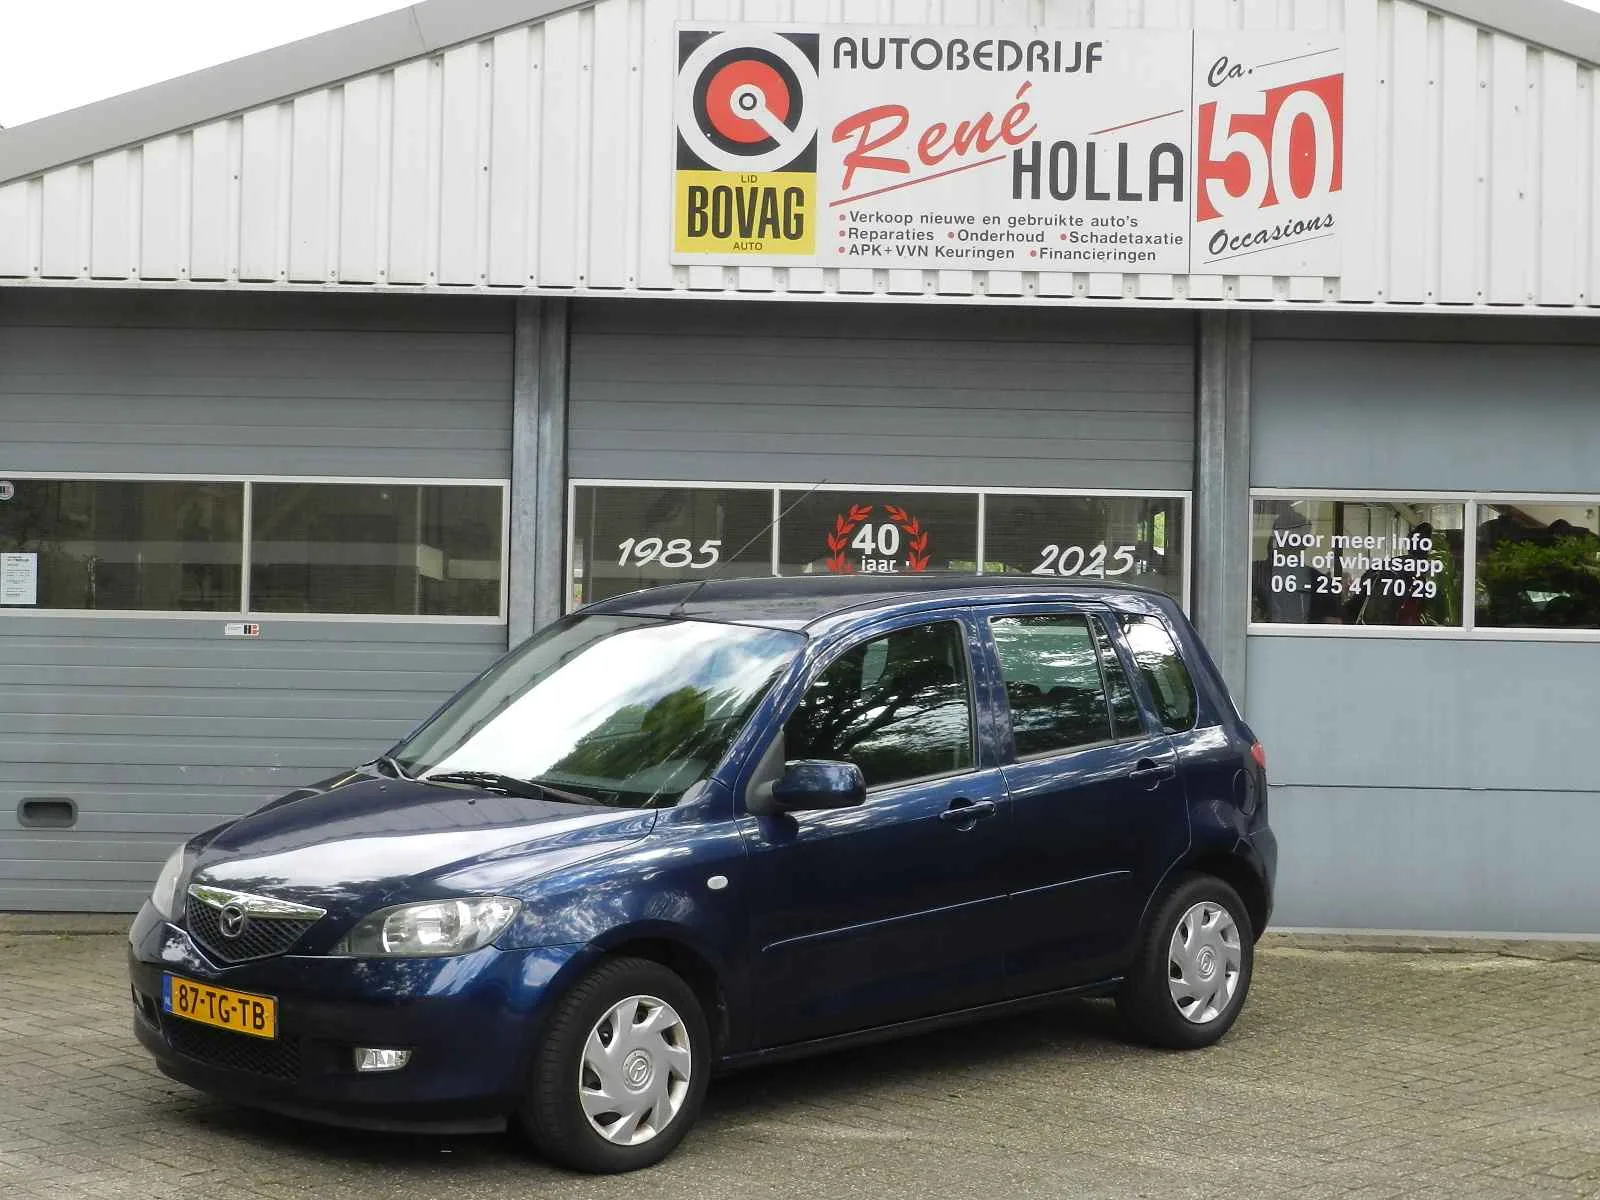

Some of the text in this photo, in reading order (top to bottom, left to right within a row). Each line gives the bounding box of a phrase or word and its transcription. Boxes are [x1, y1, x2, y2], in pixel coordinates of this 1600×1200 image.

[832, 36, 1103, 73] AUTOBEDRIJF
[1207, 56, 1253, 87] Ca.
[831, 80, 1038, 191] René
[1204, 88, 1335, 217] 50
[740, 174, 758, 184] LID
[1012, 140, 1184, 202] HOLLA
[687, 185, 805, 240] BOVAG
[849, 211, 1139, 228] Verkoop nieuwe en gebruikte auto's
[732, 242, 763, 251] AUTO
[848, 227, 1183, 245] Reparaties Onderhoud Schadetaxatie
[1208, 212, 1336, 255] Occasions
[935, 246, 1015, 261] Keuringen
[1039, 248, 1156, 263] Financieringen
[618, 537, 722, 569] 1985
[851, 523, 900, 555] 40
[1273, 530, 1433, 551] Voor meer info
[1031, 544, 1136, 576] 2025
[1272, 550, 1444, 577] bel of whatsapp
[1271, 575, 1297, 593] 06
[1316, 576, 1343, 594] 25
[1348, 577, 1372, 596] 41
[1381, 578, 1406, 597] 70
[1411, 580, 1437, 598] 29
[178, 984, 266, 1030] 87-TG-TB
